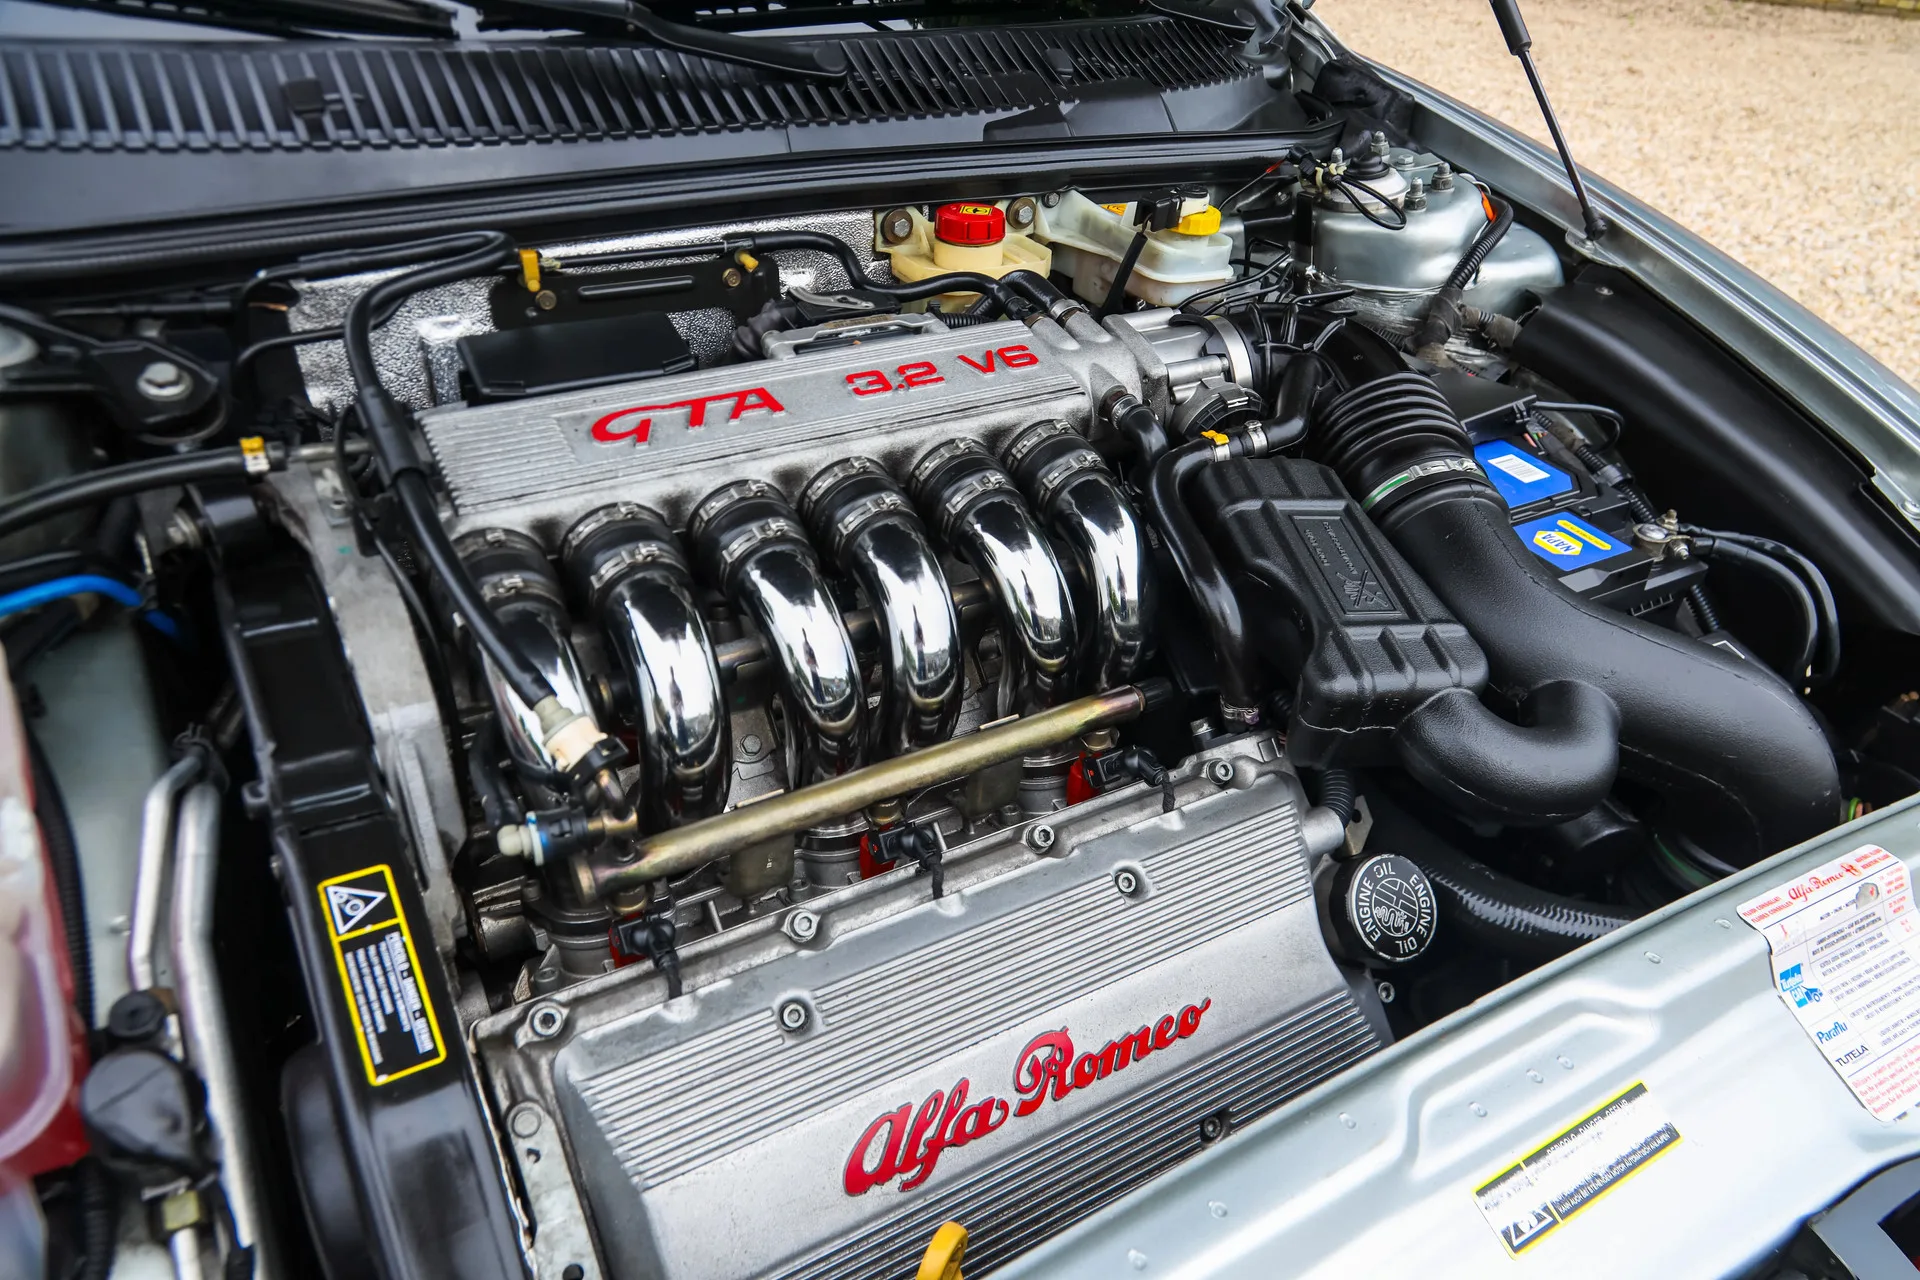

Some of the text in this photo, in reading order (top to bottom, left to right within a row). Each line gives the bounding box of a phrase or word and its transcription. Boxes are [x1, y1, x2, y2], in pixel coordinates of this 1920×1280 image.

[845, 344, 1040, 399] 3.2 V6
[591, 387, 785, 447] GTA
[1541, 532, 1575, 552] NAPA
[1358, 862, 1396, 942] ENGINE OIL
[1395, 873, 1432, 954] ENGINE OIL
[1788, 871, 1844, 902] Alfa Romeo
[1816, 1021, 1848, 1044] Paraflu
[1835, 1044, 1869, 1066] TUTELA
[843, 997, 1212, 1196] Alfa Romeo
